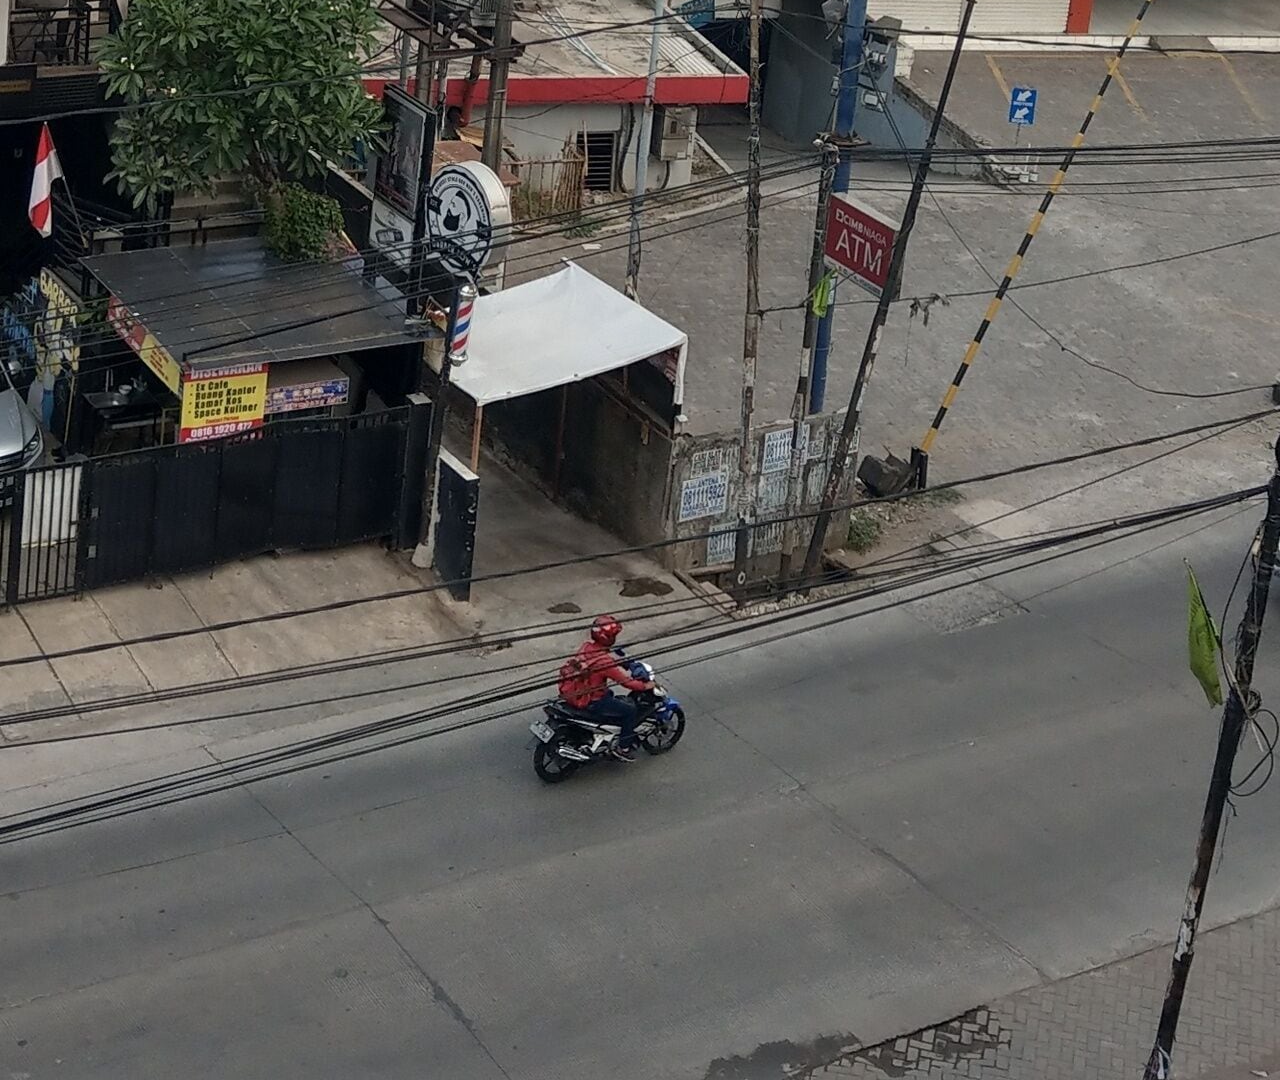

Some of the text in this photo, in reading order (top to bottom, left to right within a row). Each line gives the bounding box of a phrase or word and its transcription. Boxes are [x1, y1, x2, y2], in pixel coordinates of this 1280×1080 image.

[835, 228, 883, 276] ATM
[196, 380, 229, 392] Ex Cafe
[195, 386, 256, 402] Ruang Kantor
[194, 396, 242, 410] Kamar Kos
[194, 408, 221, 419] Space
